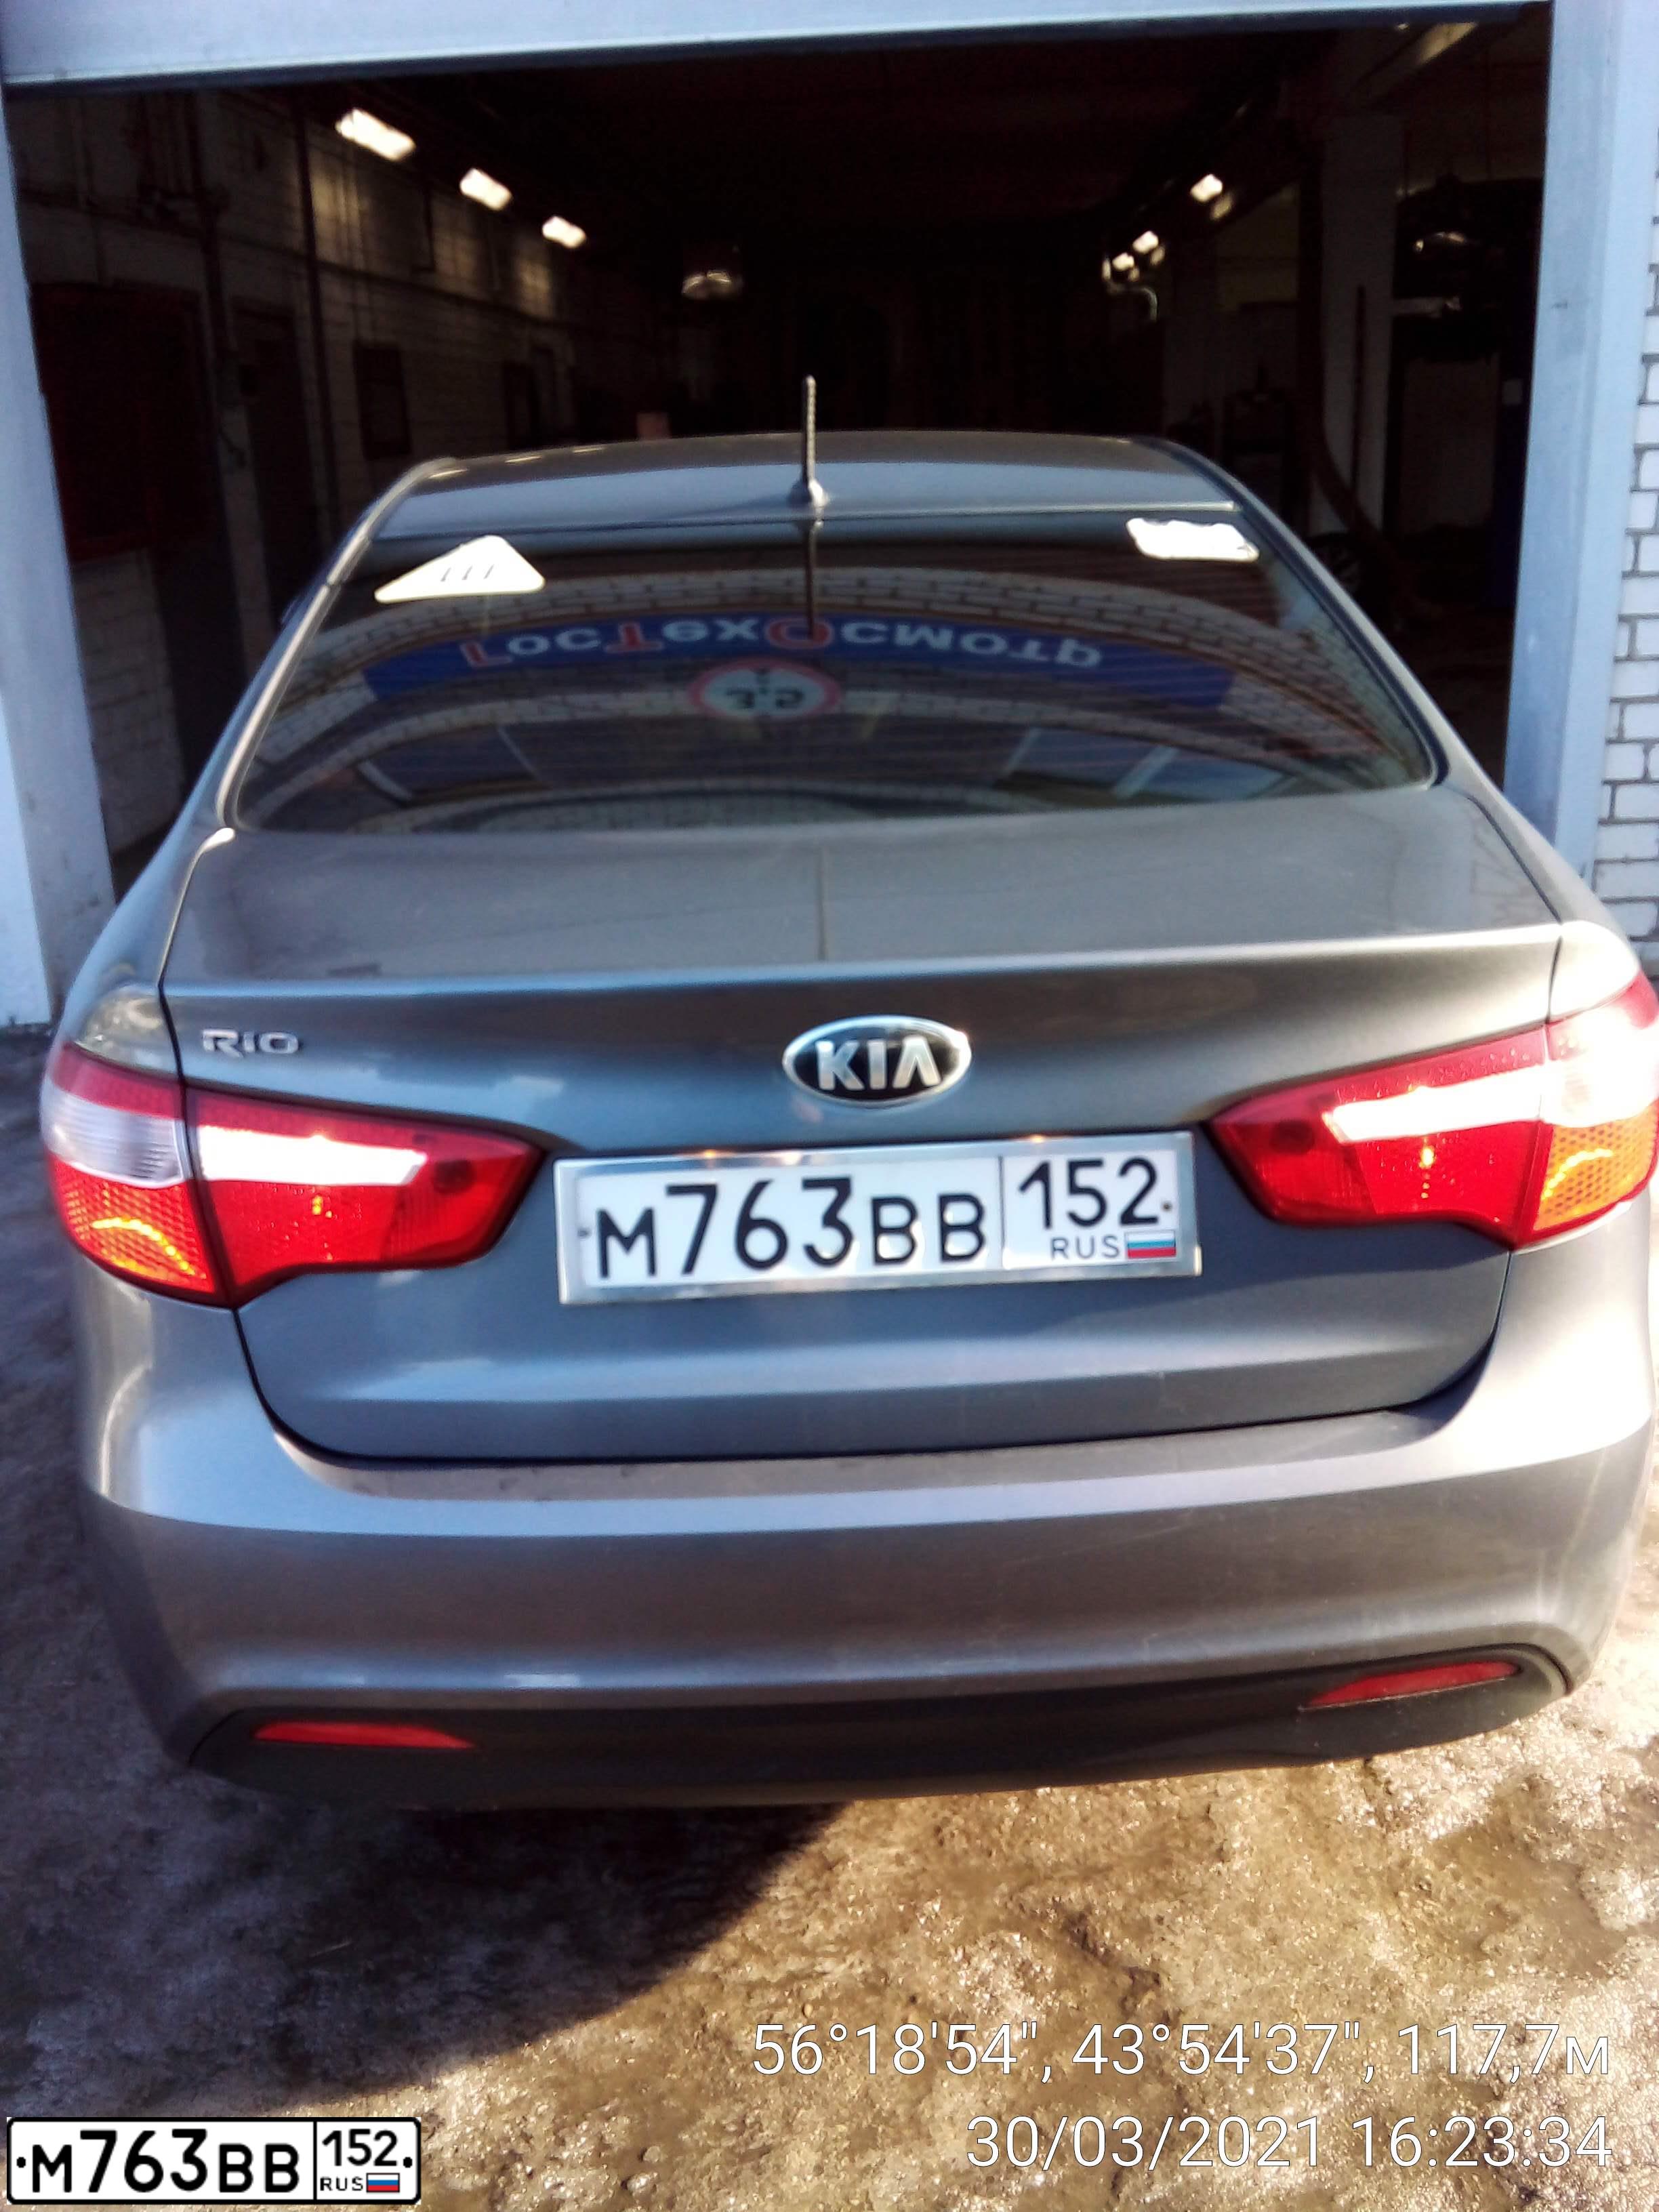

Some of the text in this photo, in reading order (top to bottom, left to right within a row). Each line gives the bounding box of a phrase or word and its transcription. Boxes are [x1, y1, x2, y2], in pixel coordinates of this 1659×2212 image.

[202, 1029, 299, 1057] RIO
[816, 1036, 942, 1091] KIA
[1017, 1156, 1160, 1229] 152
[1050, 1235, 1120, 1261] RUS
